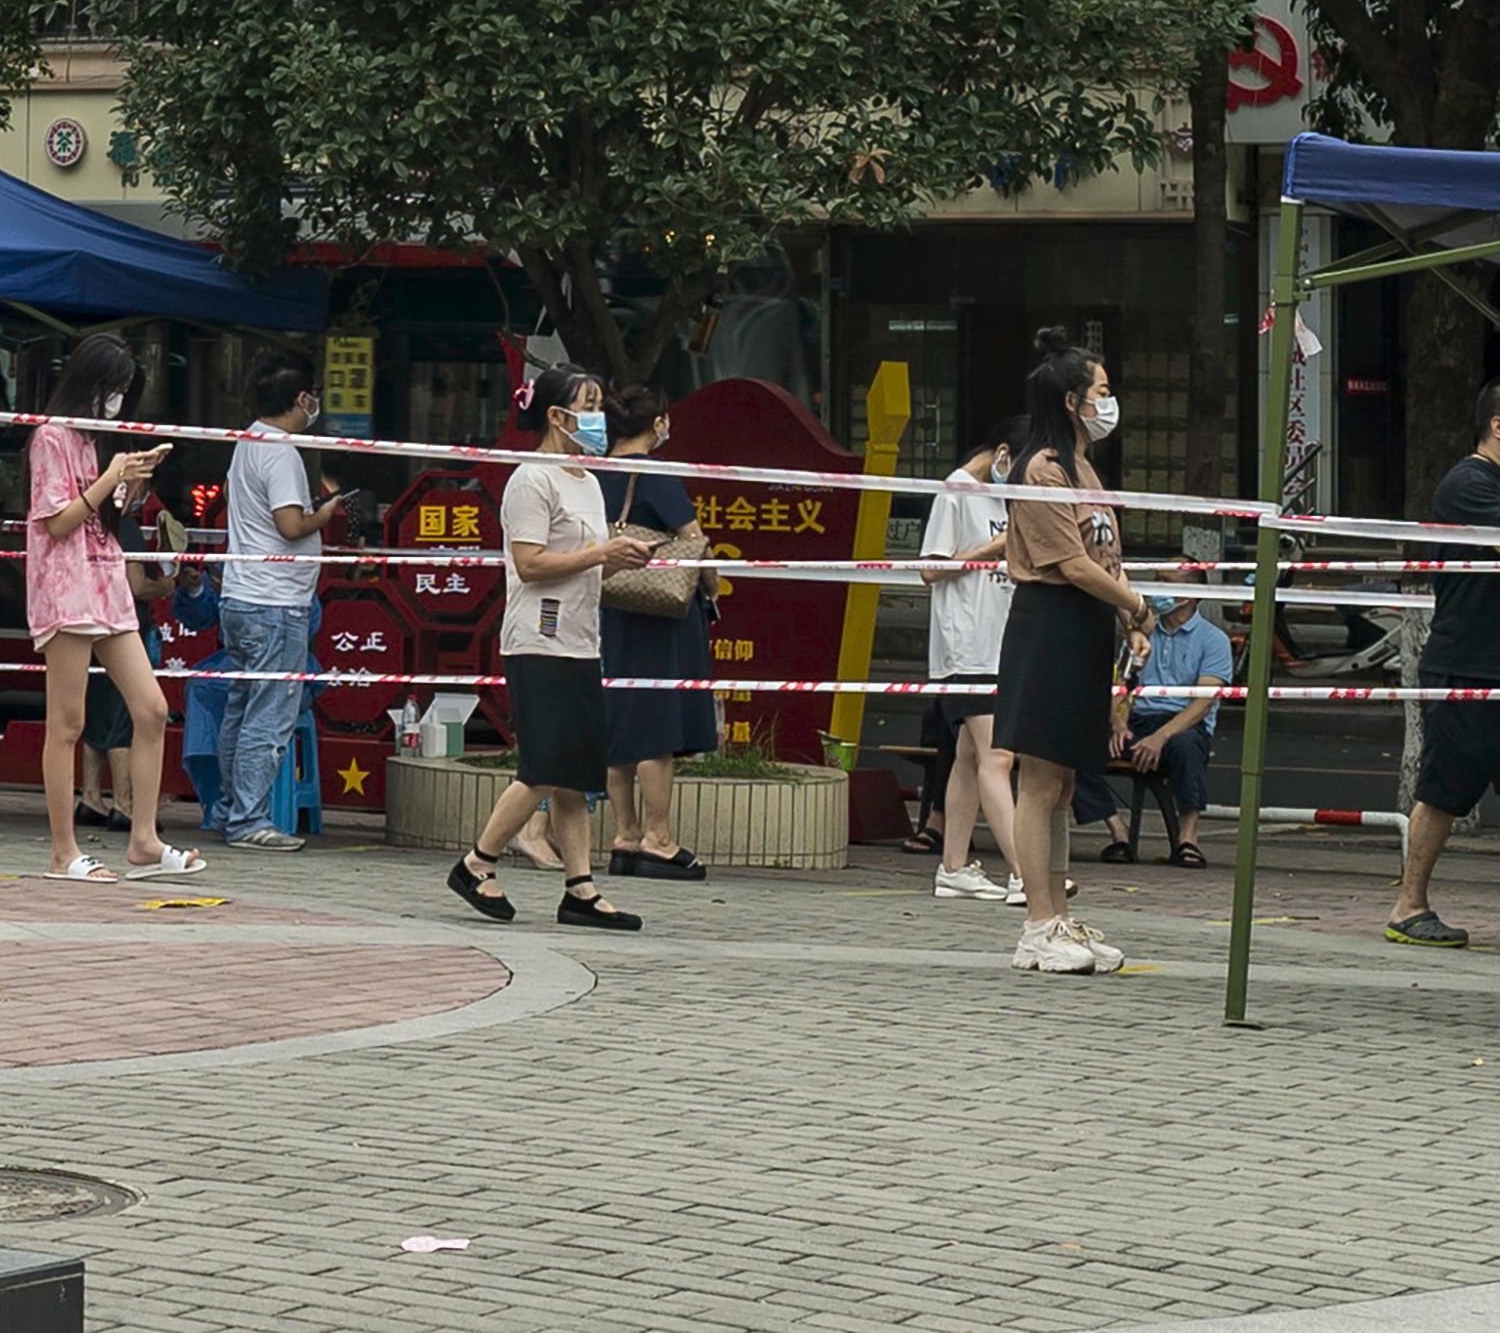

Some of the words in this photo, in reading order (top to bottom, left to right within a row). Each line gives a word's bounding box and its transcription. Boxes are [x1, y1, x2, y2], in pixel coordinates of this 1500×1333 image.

[419, 505, 480, 537] 国家
[695, 495, 826, 534] 社会主义
[415, 573, 471, 595] 民主
[330, 631, 388, 652] 公正
[709, 638, 754, 661] 信仰
